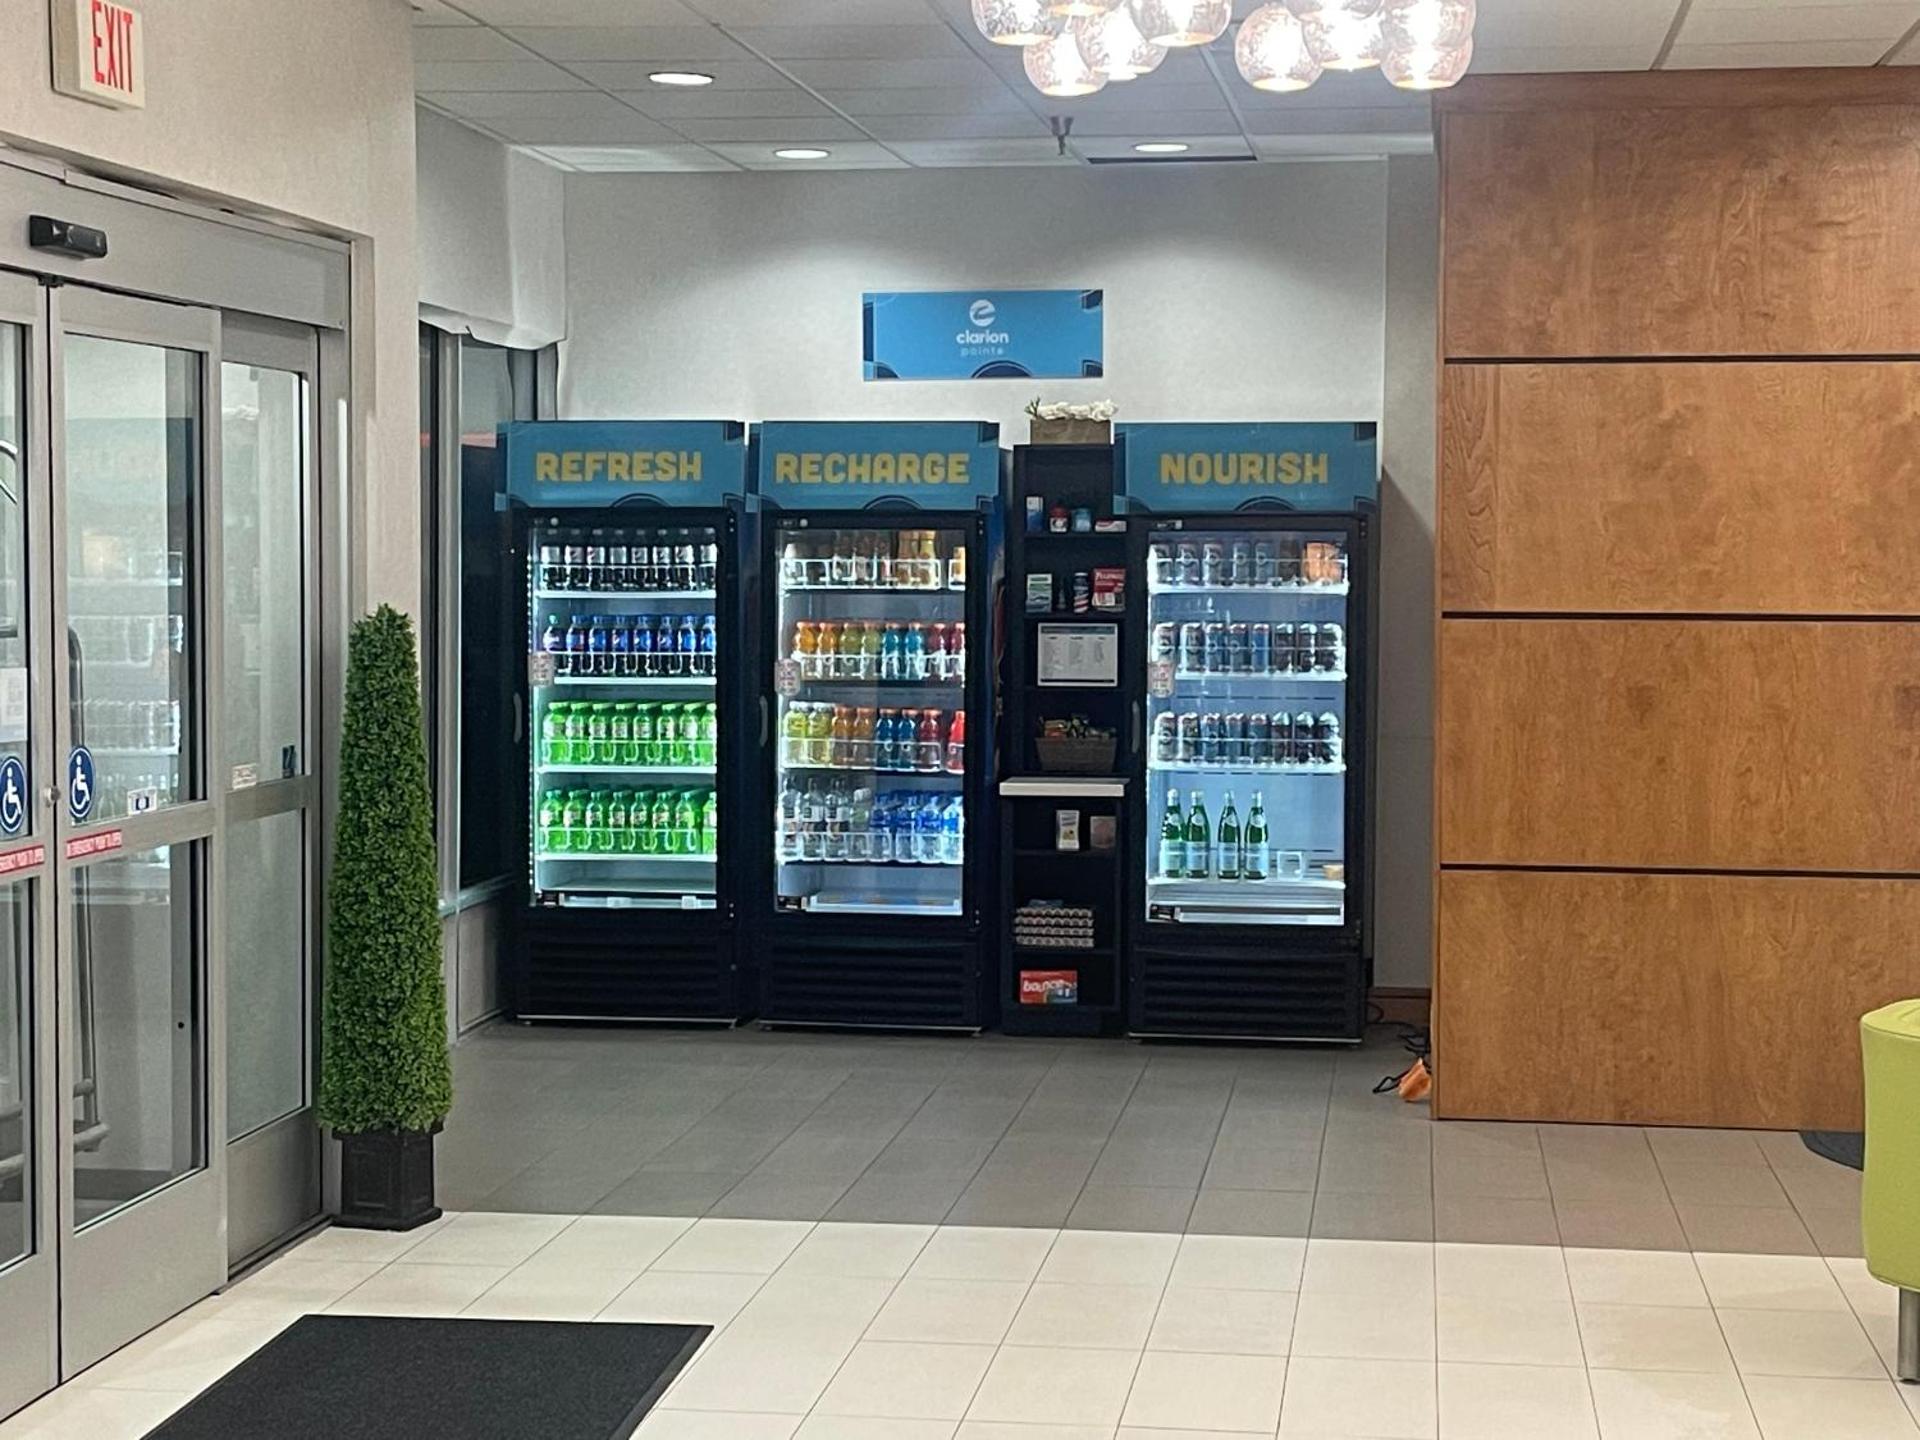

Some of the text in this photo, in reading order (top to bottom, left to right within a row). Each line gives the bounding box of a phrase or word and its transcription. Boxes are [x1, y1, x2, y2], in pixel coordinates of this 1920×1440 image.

[92, 0, 132, 92] EXIT
[956, 329, 1009, 344] clarion
[535, 451, 702, 482] REFRESH
[775, 453, 970, 484] RECHARGE
[1159, 453, 1328, 484] NOURISH
